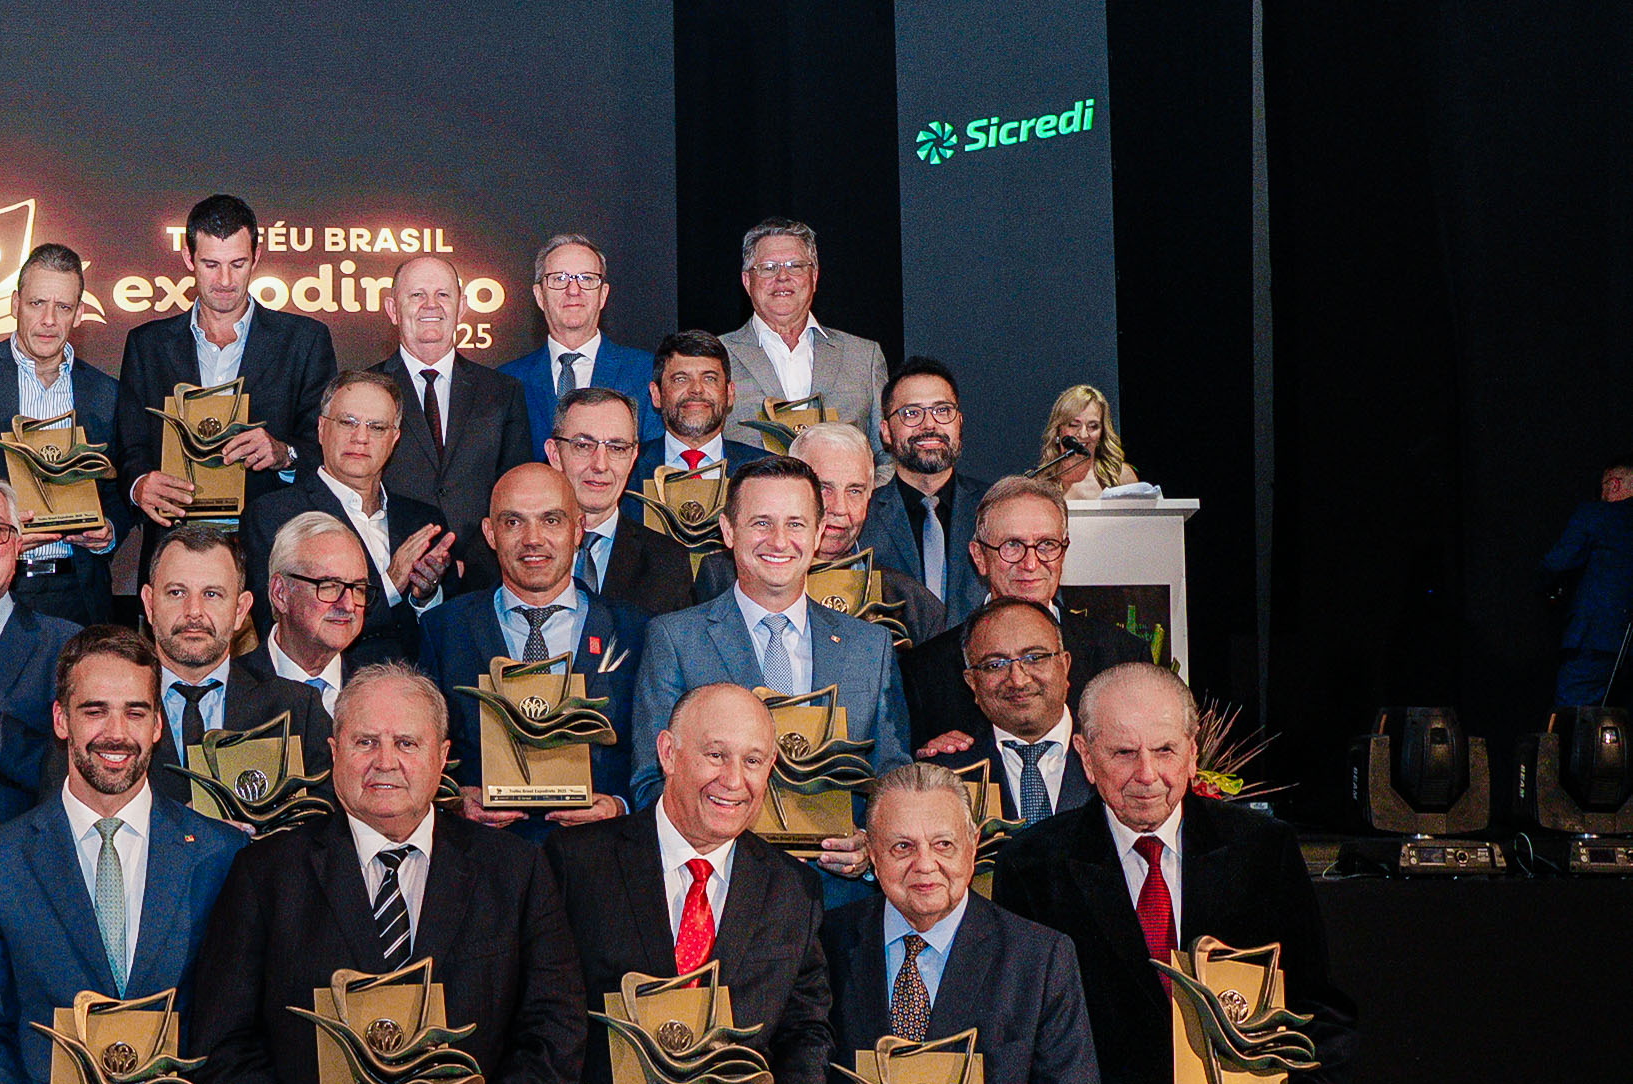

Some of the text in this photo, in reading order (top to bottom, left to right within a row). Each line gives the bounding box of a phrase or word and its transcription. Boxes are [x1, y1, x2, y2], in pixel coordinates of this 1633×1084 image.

[964, 98, 1095, 152] Sicredi
[166, 220, 454, 253] TÉU BRASIL
[112, 259, 506, 314] exodiro
